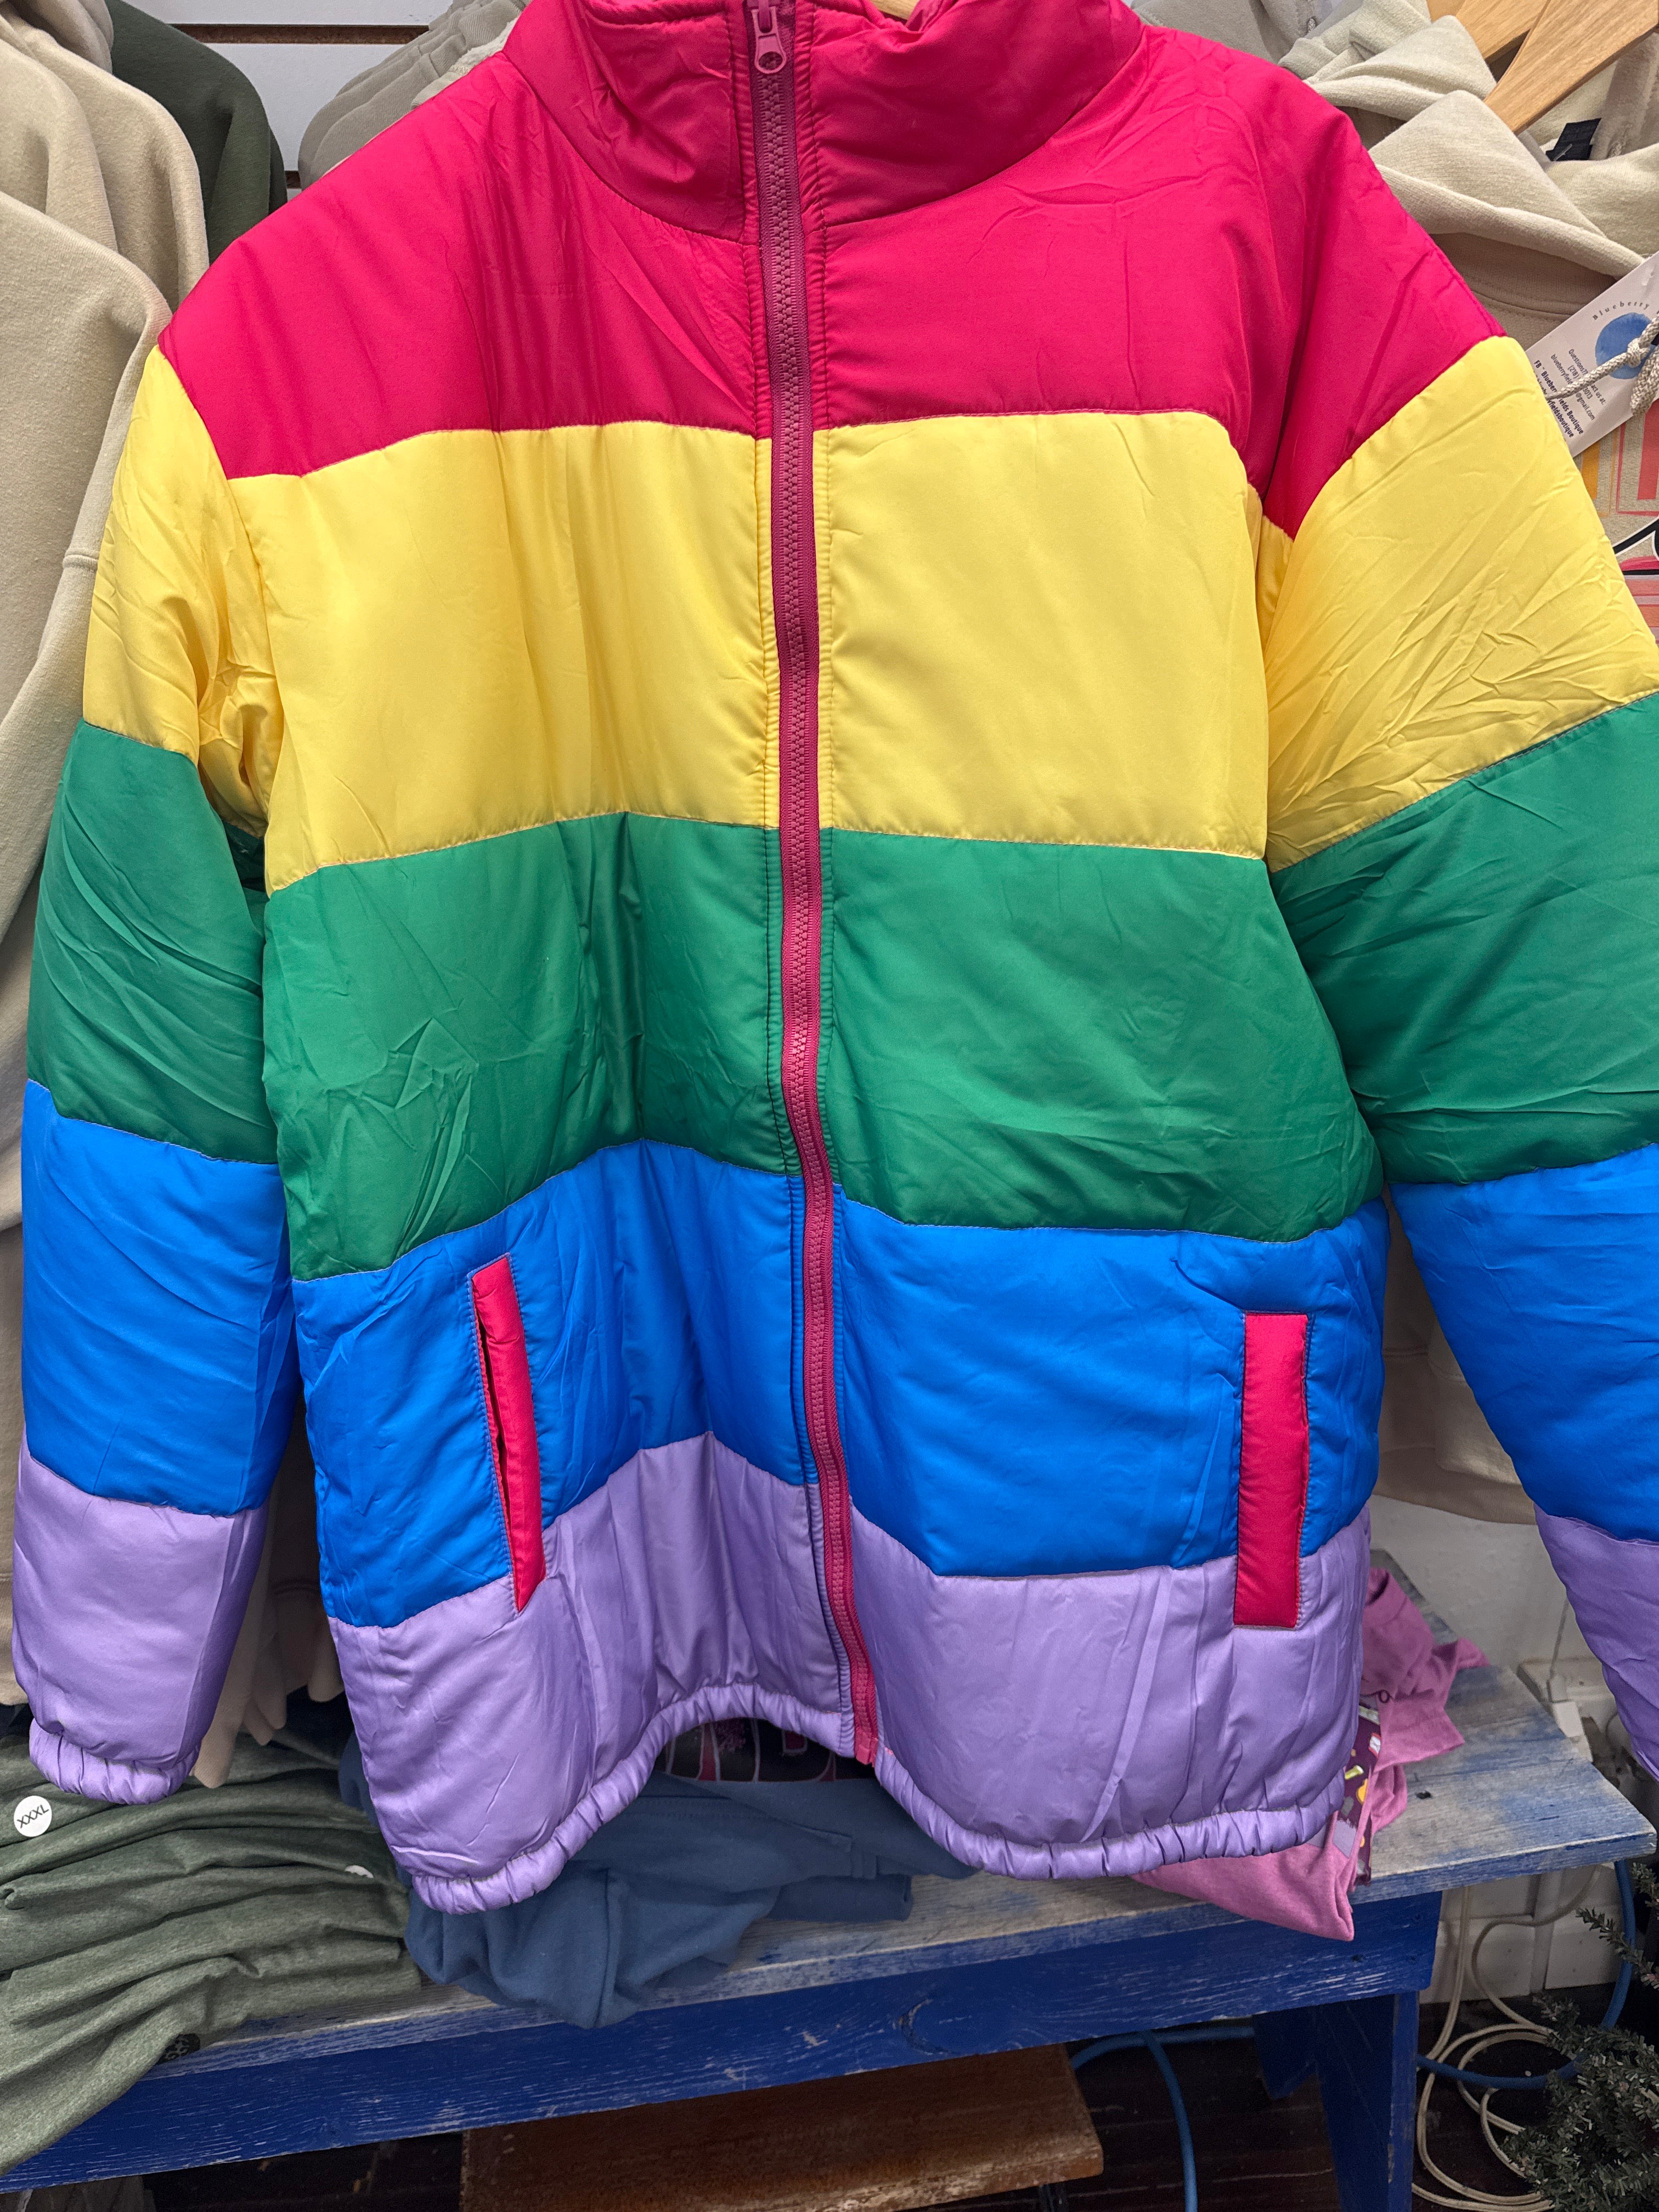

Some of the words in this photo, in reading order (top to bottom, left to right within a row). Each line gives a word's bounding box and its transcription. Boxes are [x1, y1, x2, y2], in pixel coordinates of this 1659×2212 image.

[1593, 301, 1649, 320] Blueberry
[1567, 365, 1579, 379] (218)
[1568, 349, 1588, 375] Questions??
[1534, 360, 1542, 369] FB
[1541, 371, 1558, 393] Blueberr
[1558, 398, 1570, 412] ields
[1567, 410, 1584, 435] Boutique
[16, 1804, 49, 1829] XXXL
